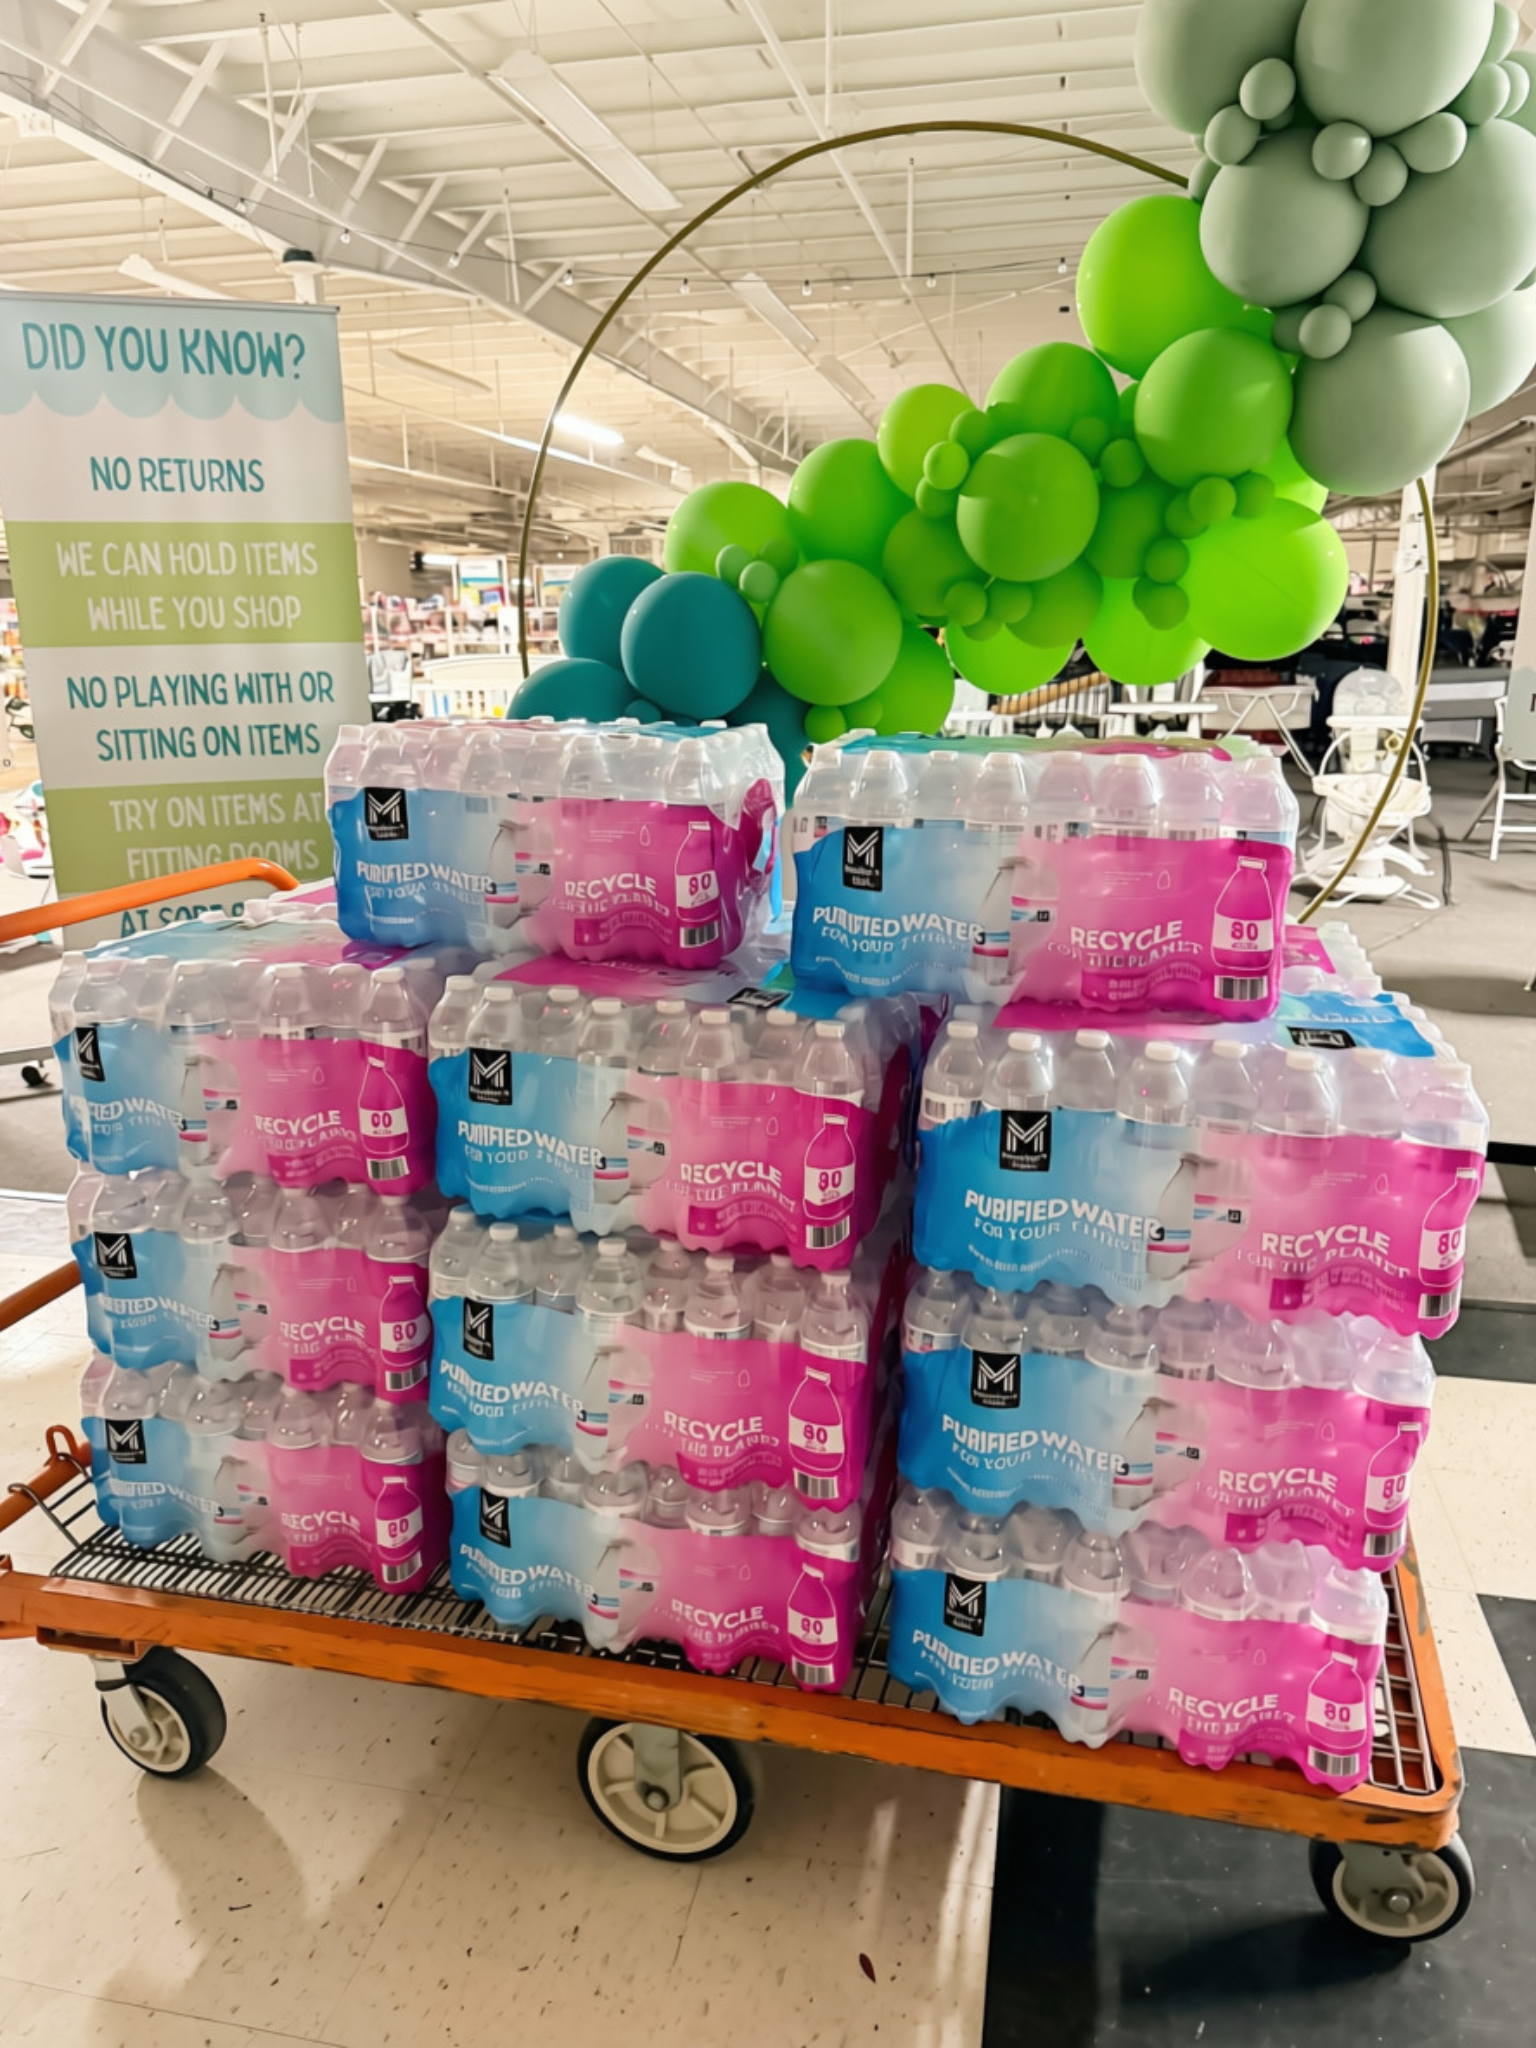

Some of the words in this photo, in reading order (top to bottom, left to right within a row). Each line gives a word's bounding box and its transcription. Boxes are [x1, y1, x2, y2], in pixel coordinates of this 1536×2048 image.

[22, 322, 86, 371] DID
[95, 326, 169, 374] YOU
[179, 328, 306, 380] KNOW?
[90, 456, 131, 491] NO
[138, 457, 265, 493] RETURNS
[56, 541, 96, 578] WE
[103, 543, 163, 577] CAN
[168, 542, 237, 576] HOLD
[244, 542, 318, 576] ITEMS
[87, 597, 166, 632] WHILE
[172, 596, 225, 630] YOU
[233, 596, 301, 629] SHOP
[66, 676, 107, 709] NO
[114, 673, 228, 708] PLAYING
[235, 672, 293, 706] WITH
[300, 671, 335, 703] OR
[96, 727, 196, 761] SITTING
[203, 726, 241, 757] ON
[248, 723, 321, 755] ITEMS
[109, 798, 162, 832] TRY
[167, 796, 206, 828] ON
[211, 793, 285, 826] ITEMS
[293, 792, 322, 823] AT
[126, 844, 221, 879] FITTING
[430, 863, 492, 893] WATER
[565, 873, 657, 899] RECYCLE
[121, 909, 149, 938] AT
[901, 913, 984, 942] WATER
[1070, 920, 1183, 951] RECYCLE
[1231, 922, 1259, 941] 80
[255, 1110, 341, 1136] RECYCLE
[534, 1130, 604, 1166] WATER
[680, 1161, 782, 1188] RECYCLE
[965, 1189, 1068, 1224] PURIFIED
[1071, 1198, 1161, 1239] WATER
[1261, 1224, 1391, 1259] RECYCLE
[1437, 1229, 1461, 1255] 80
[279, 1316, 366, 1341] RECYCLE
[393, 1322, 417, 1342] 80
[510, 1381, 583, 1412] WATER
[664, 1411, 763, 1442] RECYCLE
[803, 1424, 828, 1443] 80
[942, 1413, 1039, 1453] PURIFIED
[1040, 1429, 1125, 1473] WATER
[1218, 1467, 1338, 1495] RECYCLE
[1382, 1473, 1406, 1499] 80
[528, 1565, 597, 1600] WATER
[671, 1598, 764, 1629] RECYCLE
[1001, 1651, 1081, 1696] WATER
[1168, 1687, 1279, 1719] RECYCLE
[1324, 1703, 1351, 1722] 80
